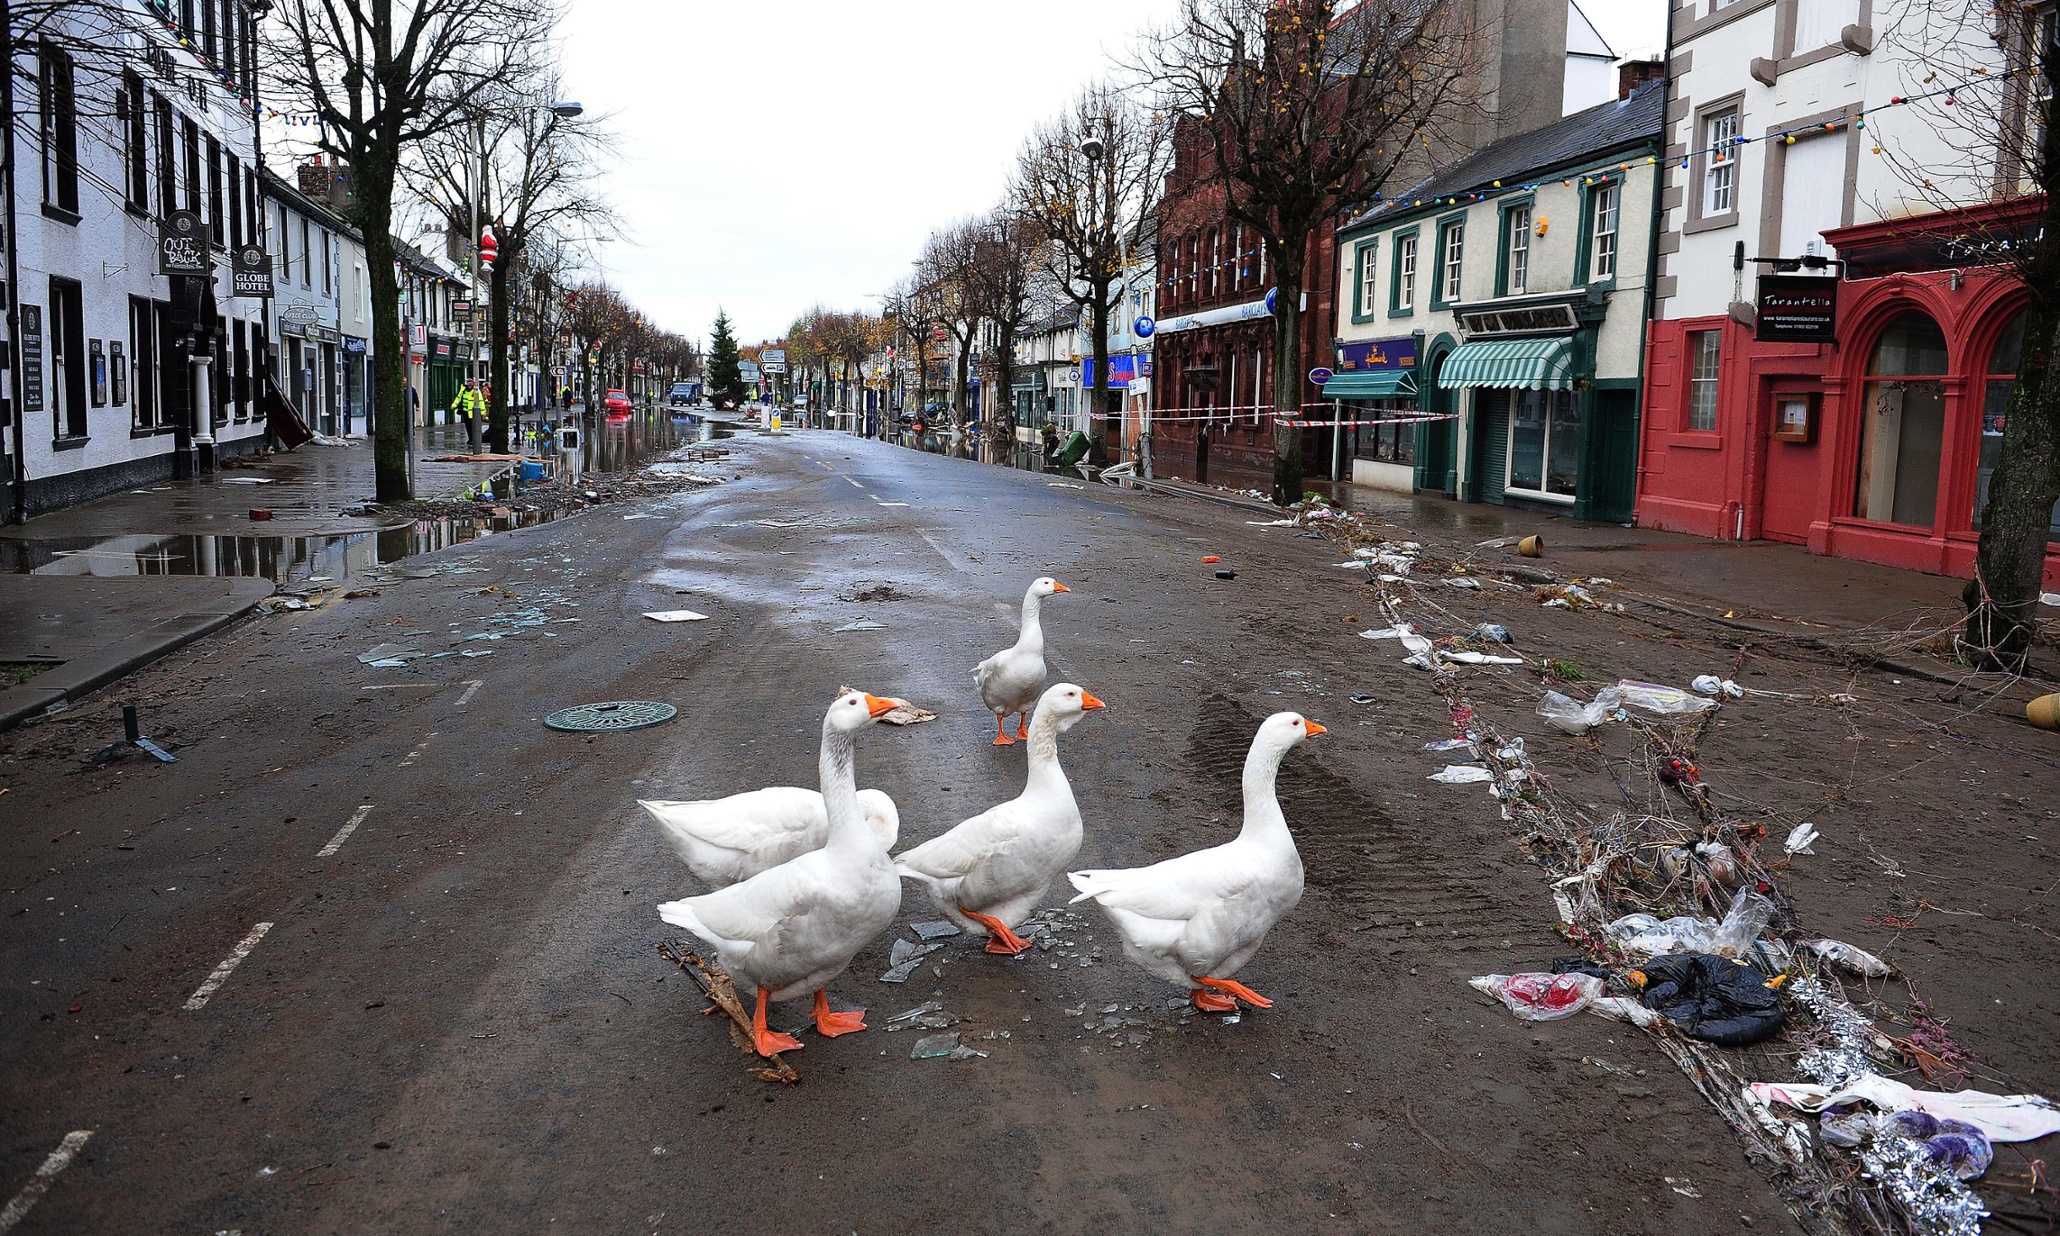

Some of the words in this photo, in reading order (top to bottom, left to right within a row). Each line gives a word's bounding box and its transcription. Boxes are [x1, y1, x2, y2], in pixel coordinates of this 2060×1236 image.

[164, 237, 193, 254] OUT
[169, 250, 201, 265] BACK
[235, 273, 270, 283] GLOBE
[235, 282, 271, 291] HOTEL
[1764, 294, 1831, 306] Tarantella
